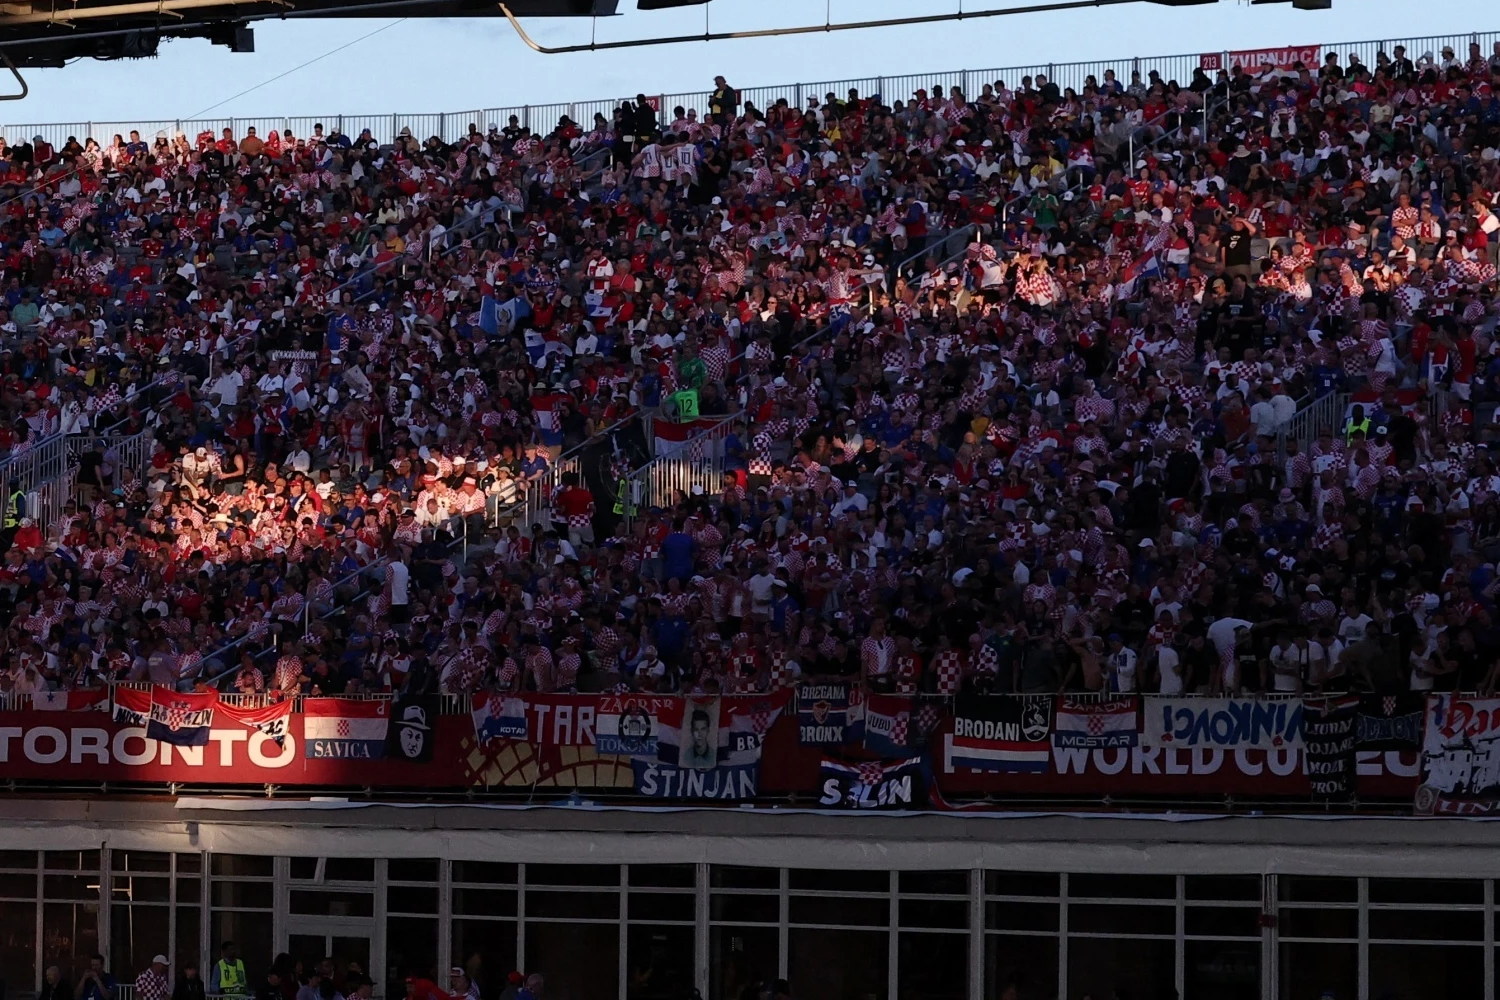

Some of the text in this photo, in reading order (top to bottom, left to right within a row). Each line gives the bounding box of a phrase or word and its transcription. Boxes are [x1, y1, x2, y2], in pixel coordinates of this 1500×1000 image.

[1203, 56, 1217, 69] 213
[680, 398, 693, 413] 12
[801, 685, 846, 700] BREGANA
[800, 725, 844, 743] BRONX
[1061, 735, 1131, 747] MOSTAR
[313, 740, 371, 759] SAVICA
[640, 762, 757, 799] ŠTINJAN
